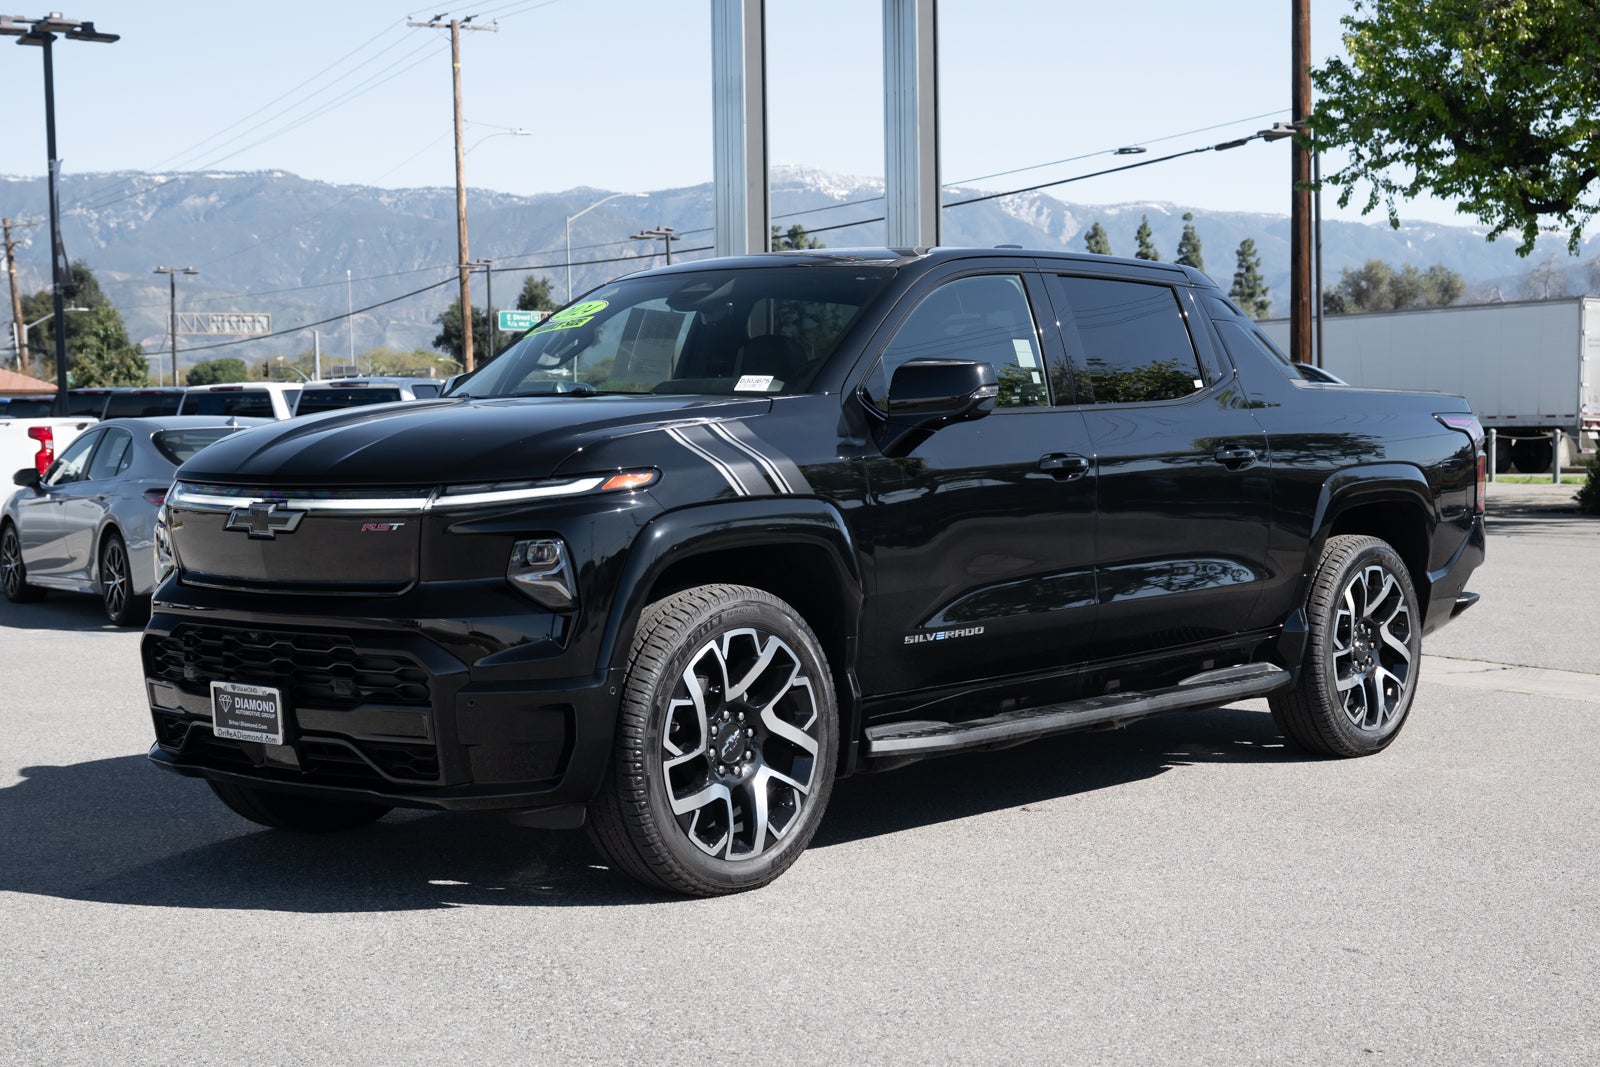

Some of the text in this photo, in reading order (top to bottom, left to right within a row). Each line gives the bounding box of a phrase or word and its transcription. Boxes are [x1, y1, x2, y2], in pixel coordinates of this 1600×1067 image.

[361, 522, 405, 532] RST
[903, 626, 985, 644] SILVERADO
[237, 685, 258, 693] DIAMOND
[234, 697, 275, 712] DIAMOND
[235, 709, 261, 717] AUTOMOTIVE
[217, 729, 278, 743] DriveADiamond.com
